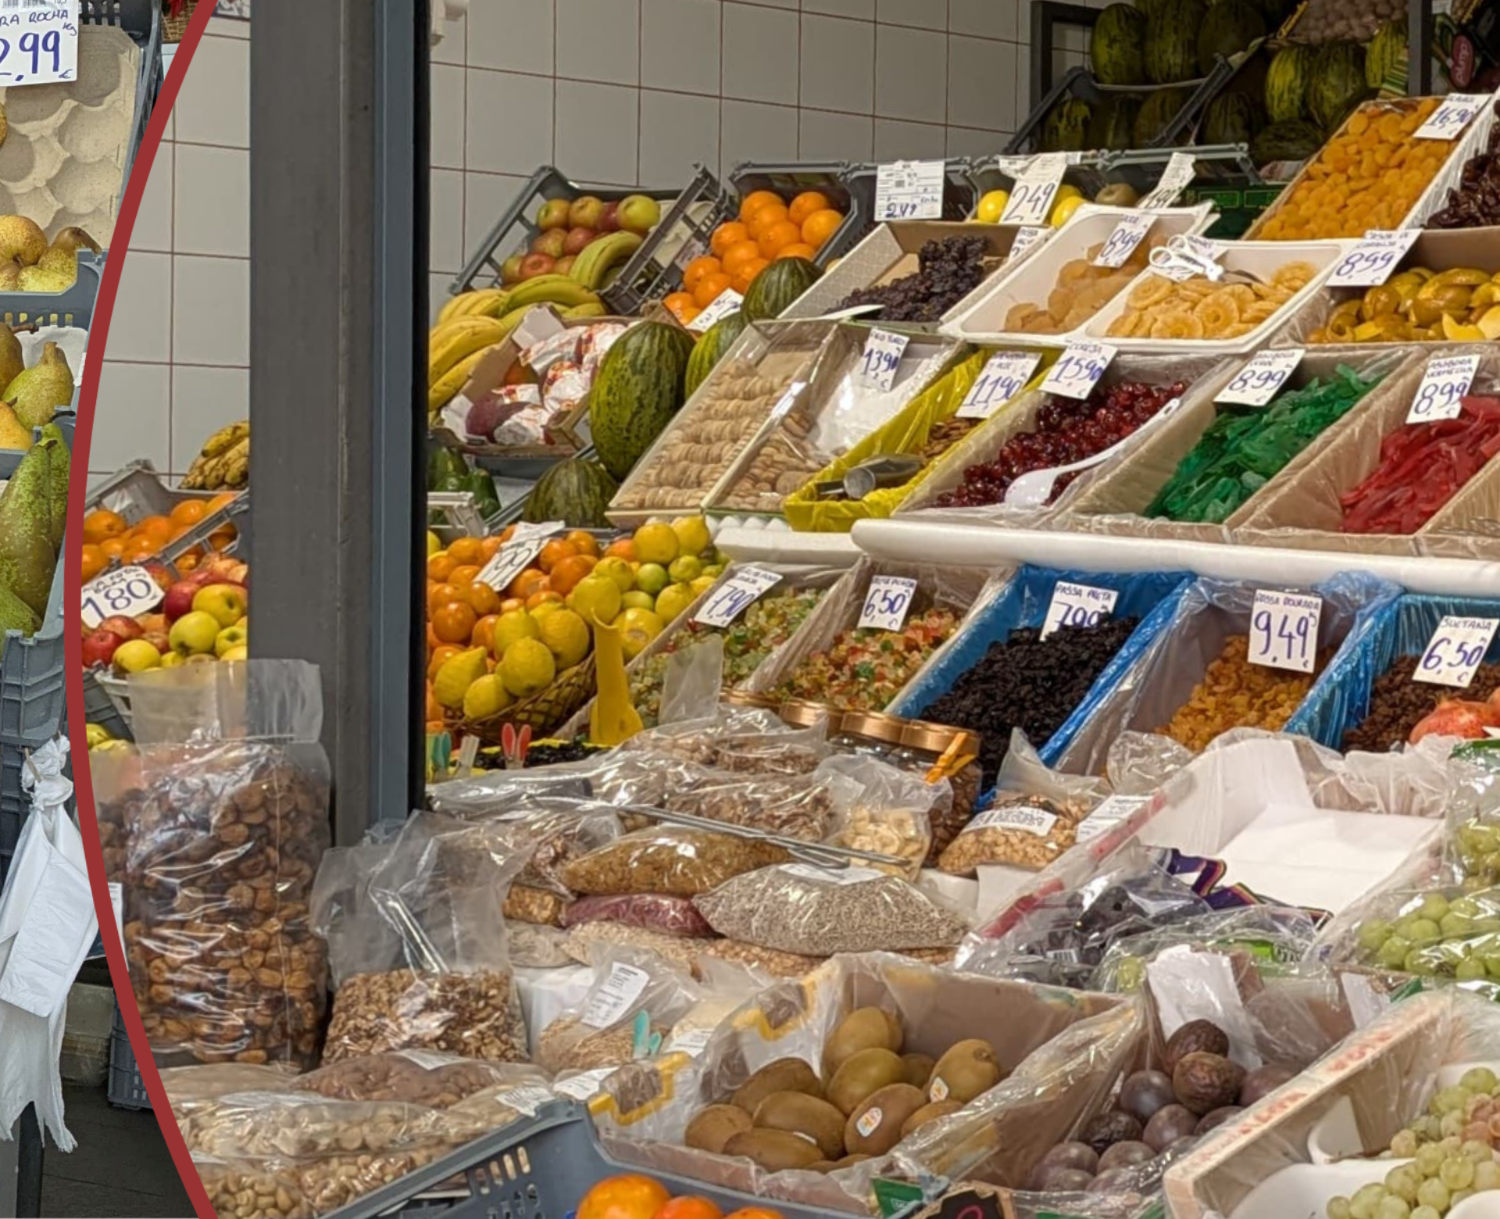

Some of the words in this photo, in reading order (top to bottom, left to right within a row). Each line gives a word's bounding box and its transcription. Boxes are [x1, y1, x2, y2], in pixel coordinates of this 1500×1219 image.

[864, 588, 906, 622] 6,50
[1055, 583, 1085, 598] PASSA
[1086, 589, 1112, 602] PRETA
[1281, 595, 1320, 611] DOURADA
[1440, 617, 1492, 630] SULTANA
[1254, 611, 1310, 663] 9,49
[1423, 637, 1485, 675] 6,50
